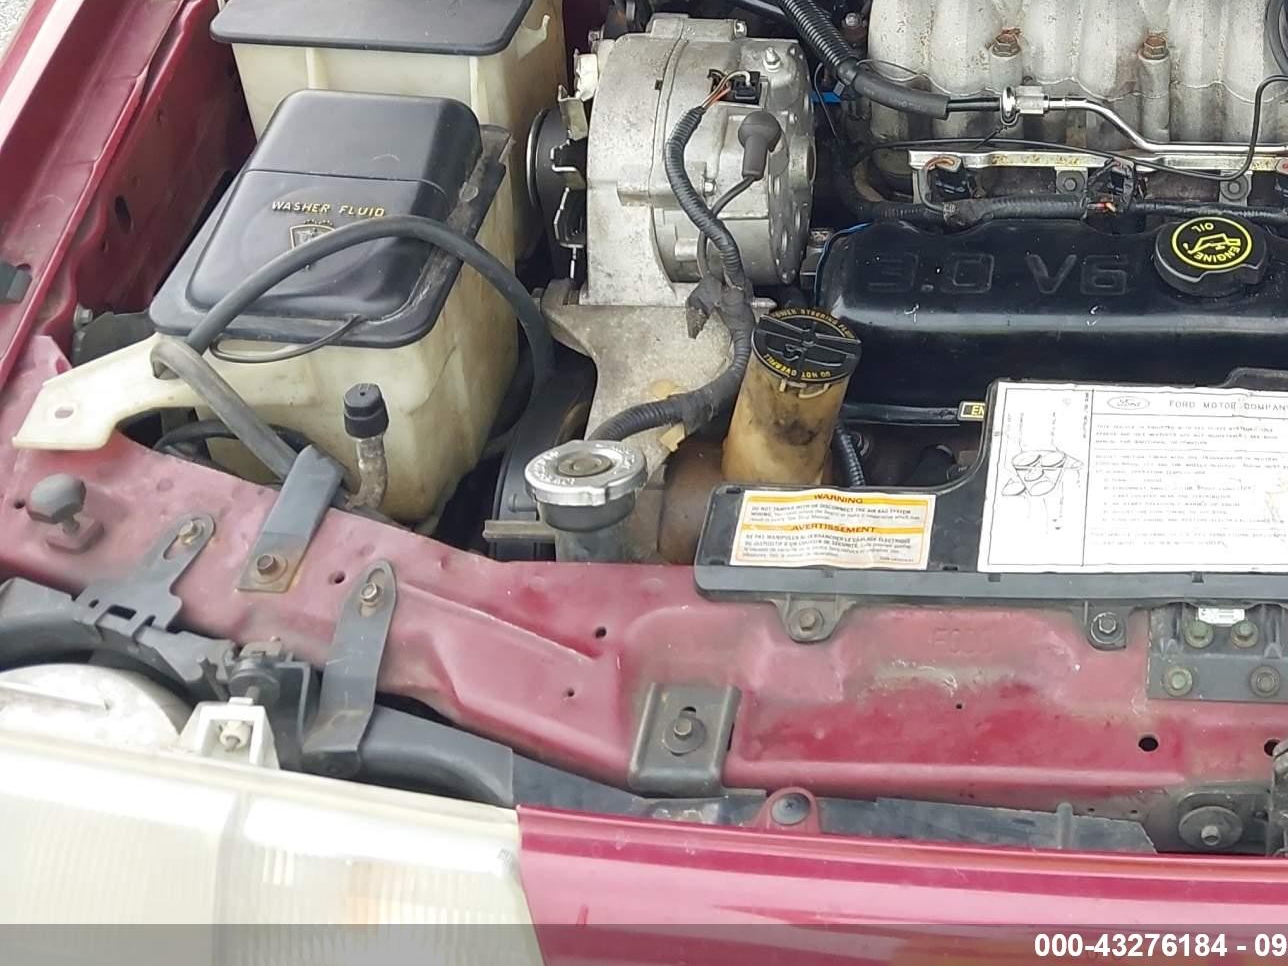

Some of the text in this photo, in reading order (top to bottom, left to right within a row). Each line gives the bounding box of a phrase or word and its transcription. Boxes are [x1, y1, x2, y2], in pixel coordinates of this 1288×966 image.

[271, 201, 386, 218] WASHER FLUID
[1191, 222, 1241, 263] ENGINE OIL
[867, 251, 1130, 295] 3.0 V6
[1169, 400, 1195, 408] FORD
[1203, 400, 1236, 410] MOTOR
[814, 493, 863, 504] WARNING
[792, 523, 875, 533] AVERTISSEMENT
